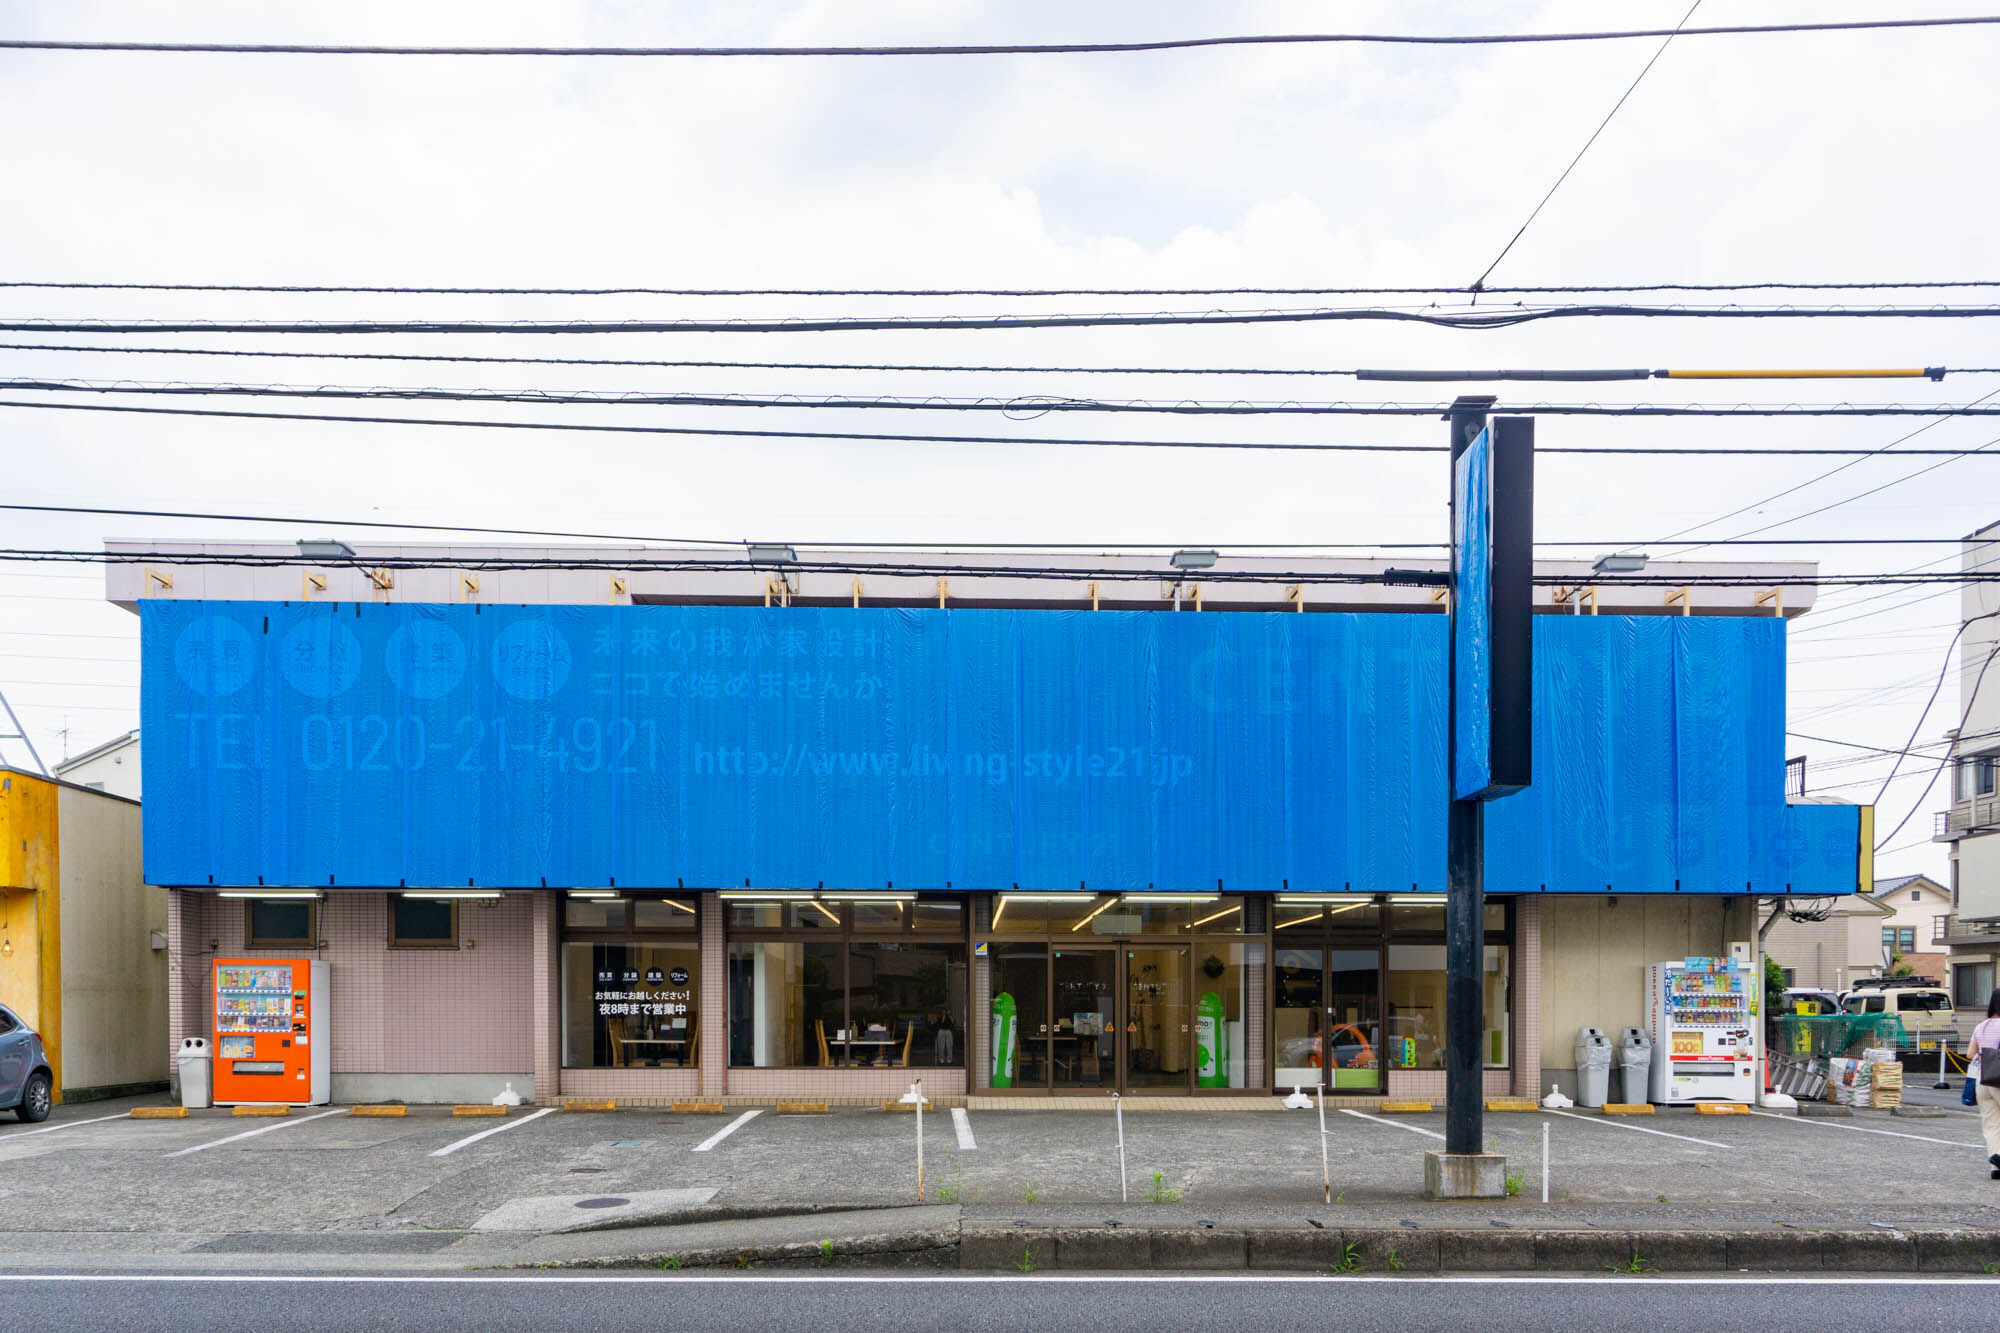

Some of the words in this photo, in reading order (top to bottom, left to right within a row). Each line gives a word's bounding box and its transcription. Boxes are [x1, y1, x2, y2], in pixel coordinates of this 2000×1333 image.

[300, 712, 659, 774] 0120-21-4921
[694, 742, 1194, 787] http://www.livng-style21.jp
[599, 1003, 687, 1016] 夜8時まで営業中
